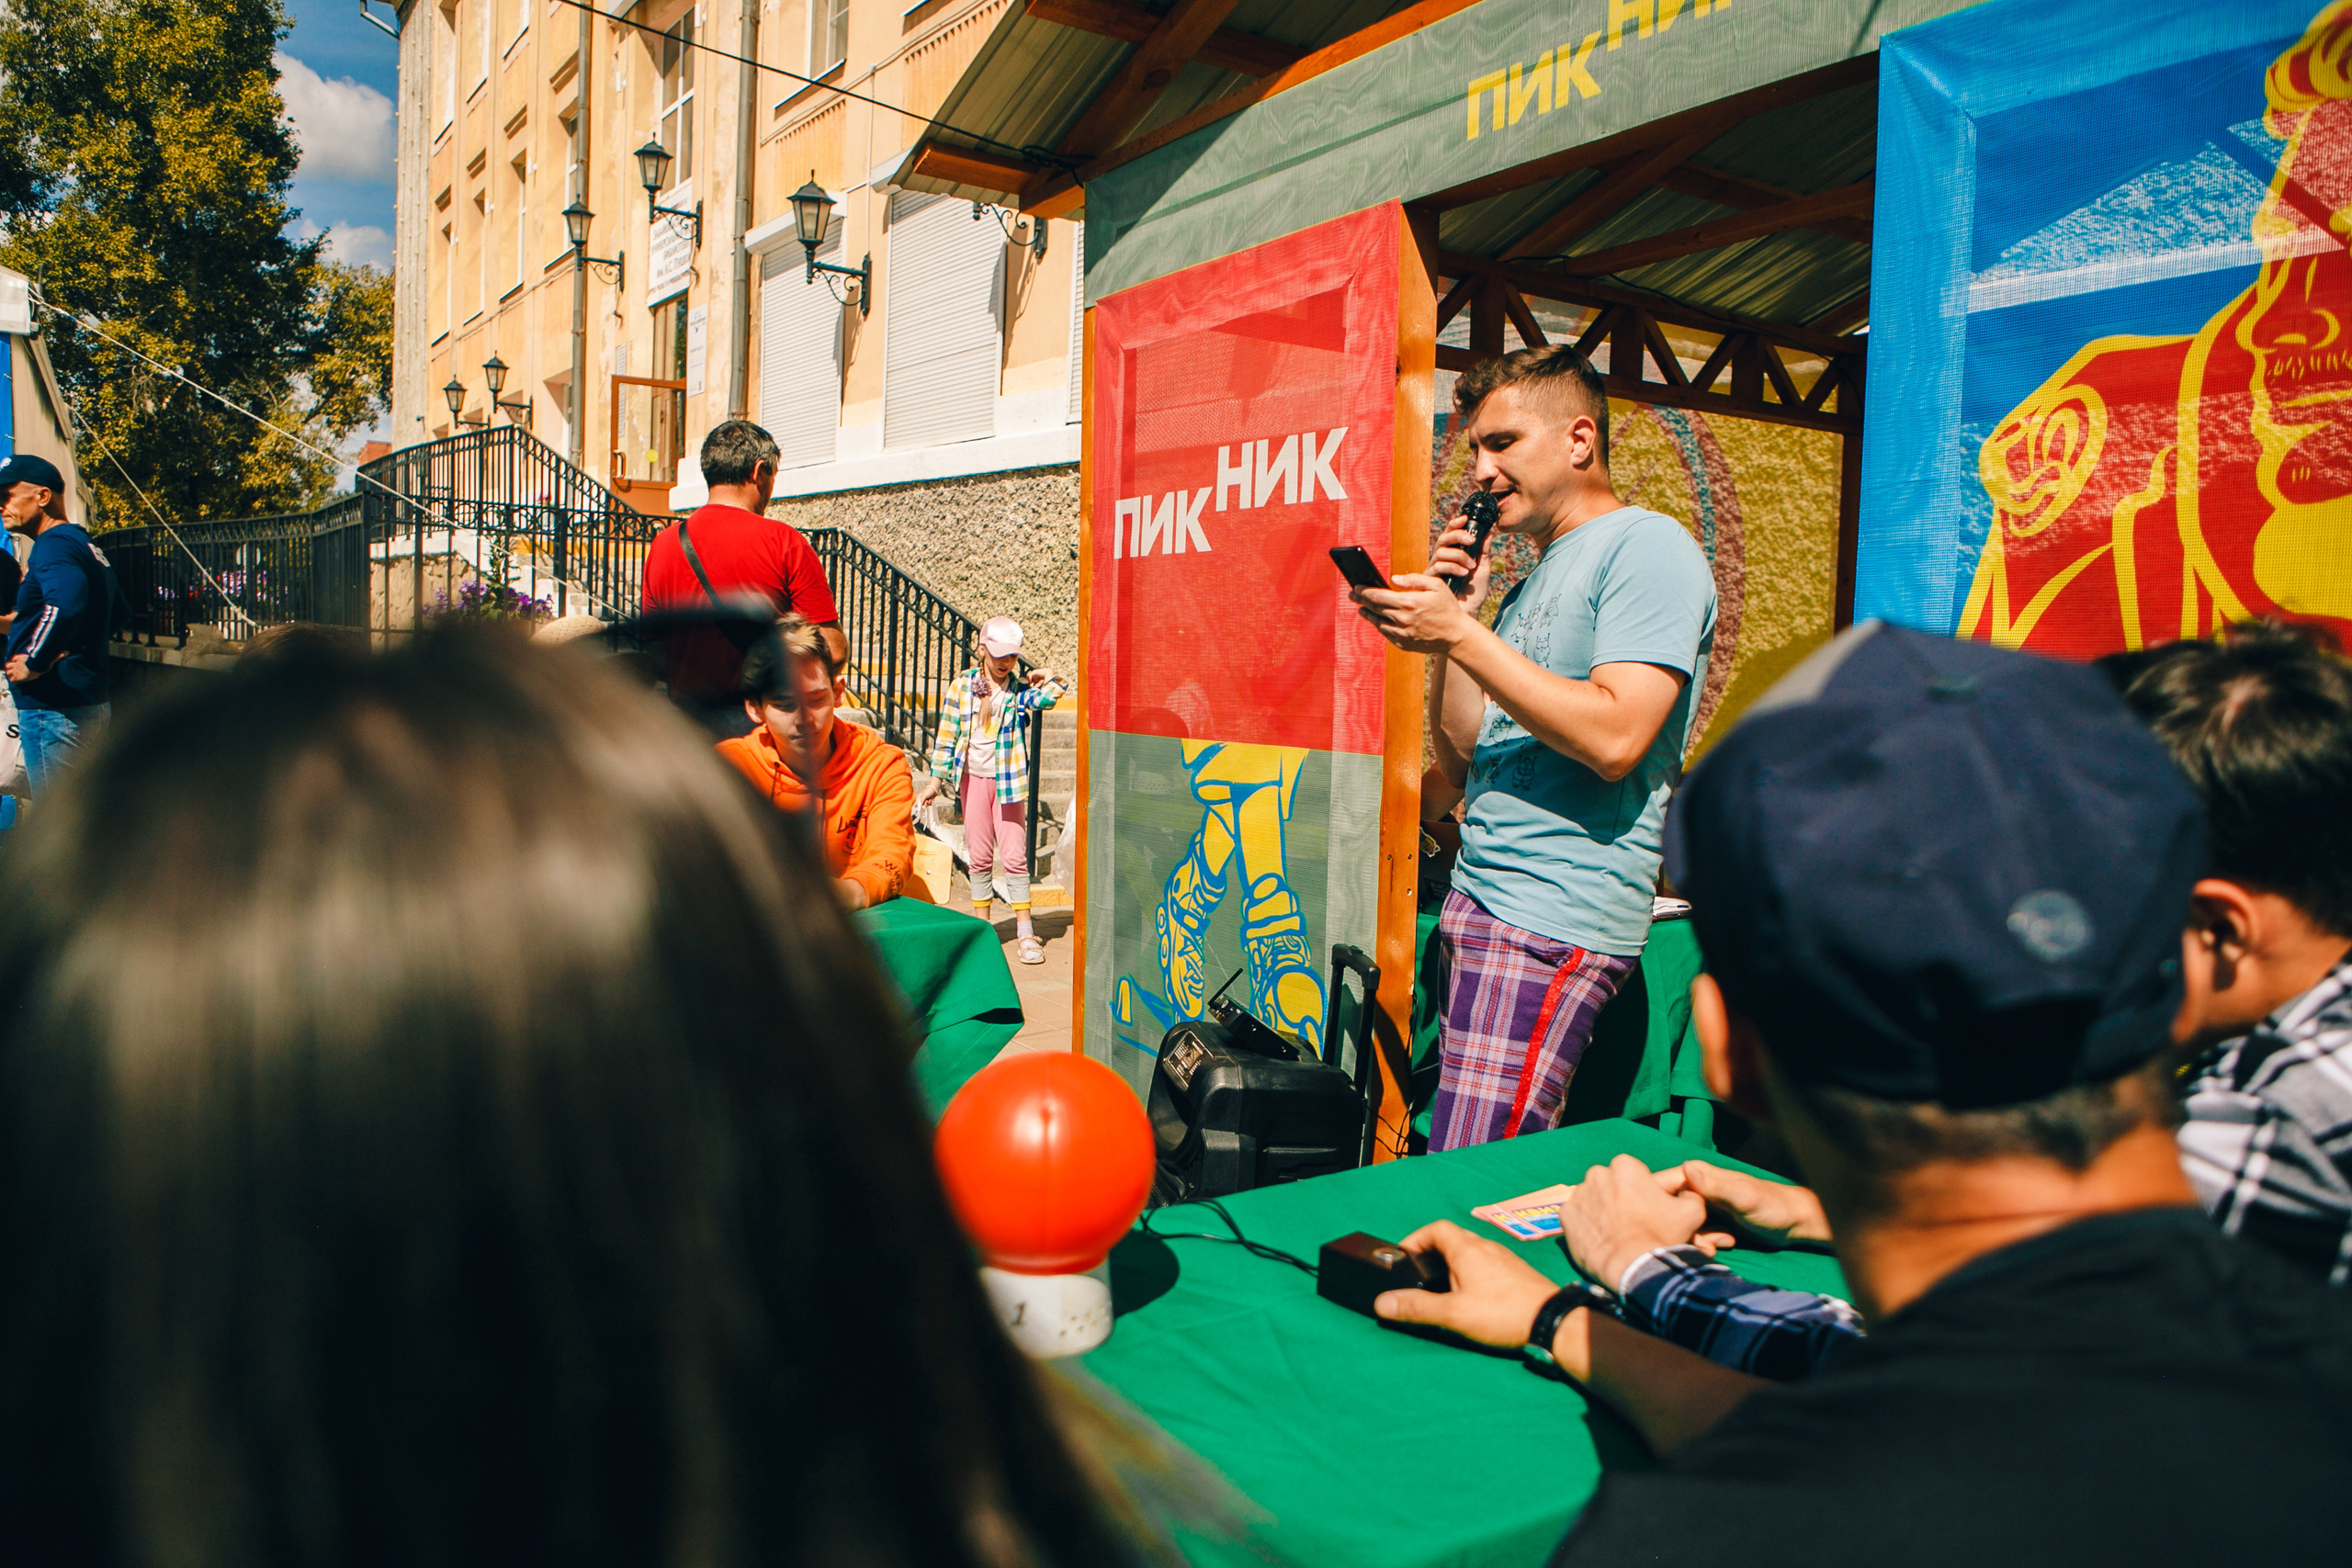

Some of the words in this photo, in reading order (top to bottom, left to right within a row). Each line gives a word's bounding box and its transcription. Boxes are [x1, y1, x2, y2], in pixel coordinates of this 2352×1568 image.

[1467, 29, 1602, 141] ПИК
[1114, 486, 1213, 559] ПИК
[1216, 426, 1349, 513] НИК
